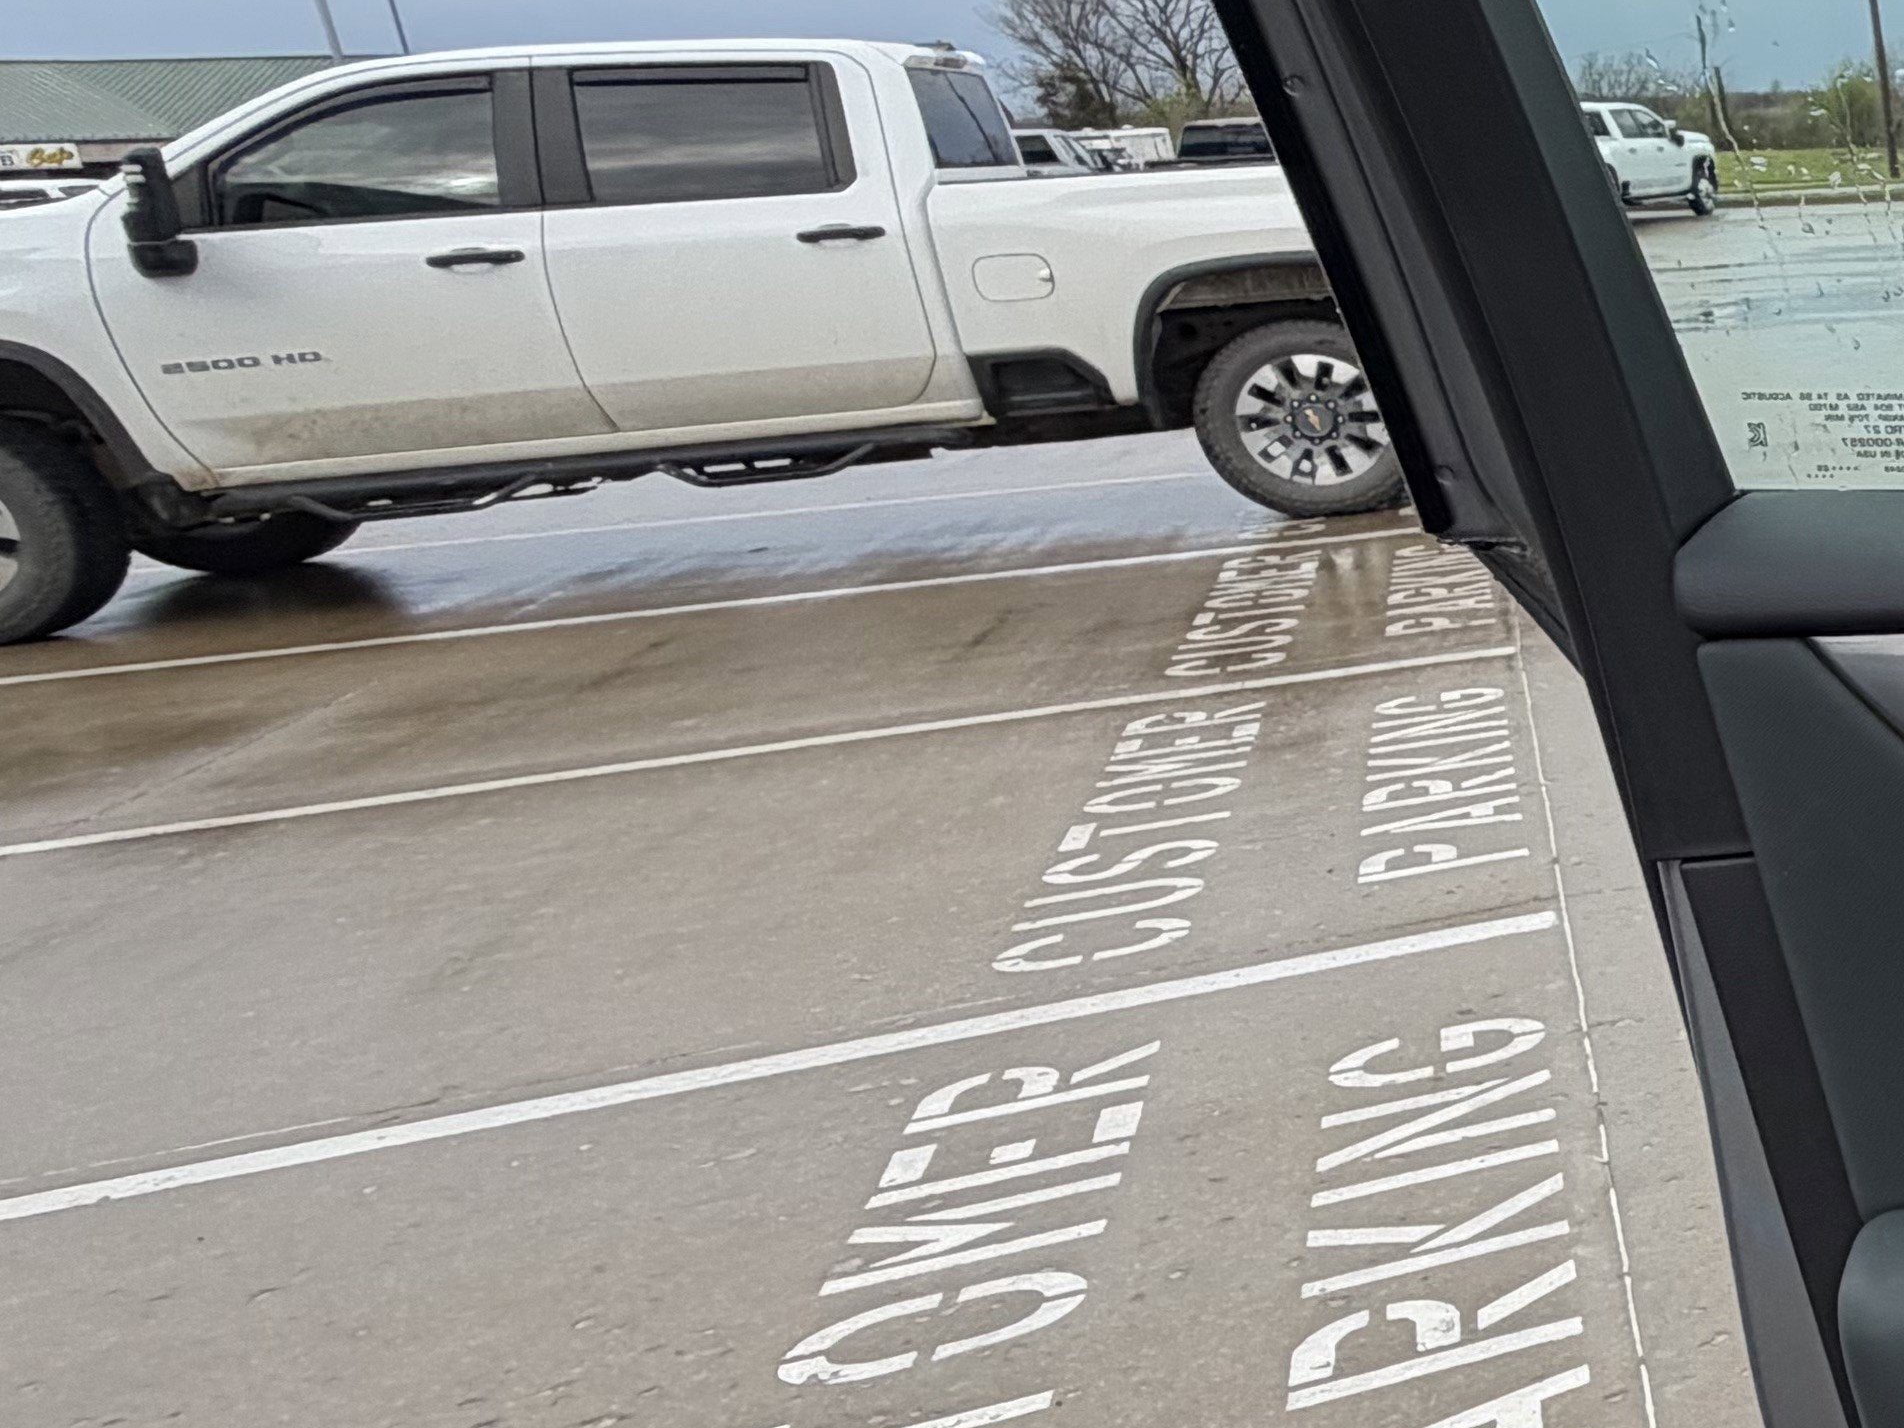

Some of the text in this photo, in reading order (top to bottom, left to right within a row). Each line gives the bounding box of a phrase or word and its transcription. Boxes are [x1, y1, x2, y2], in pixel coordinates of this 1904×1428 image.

[160, 351, 323, 375] 2500 HD
[1164, 548, 1323, 677] CUSTOMER
[991, 700, 1267, 972] CUSTOMER
[1357, 686, 1531, 885] PARKING
